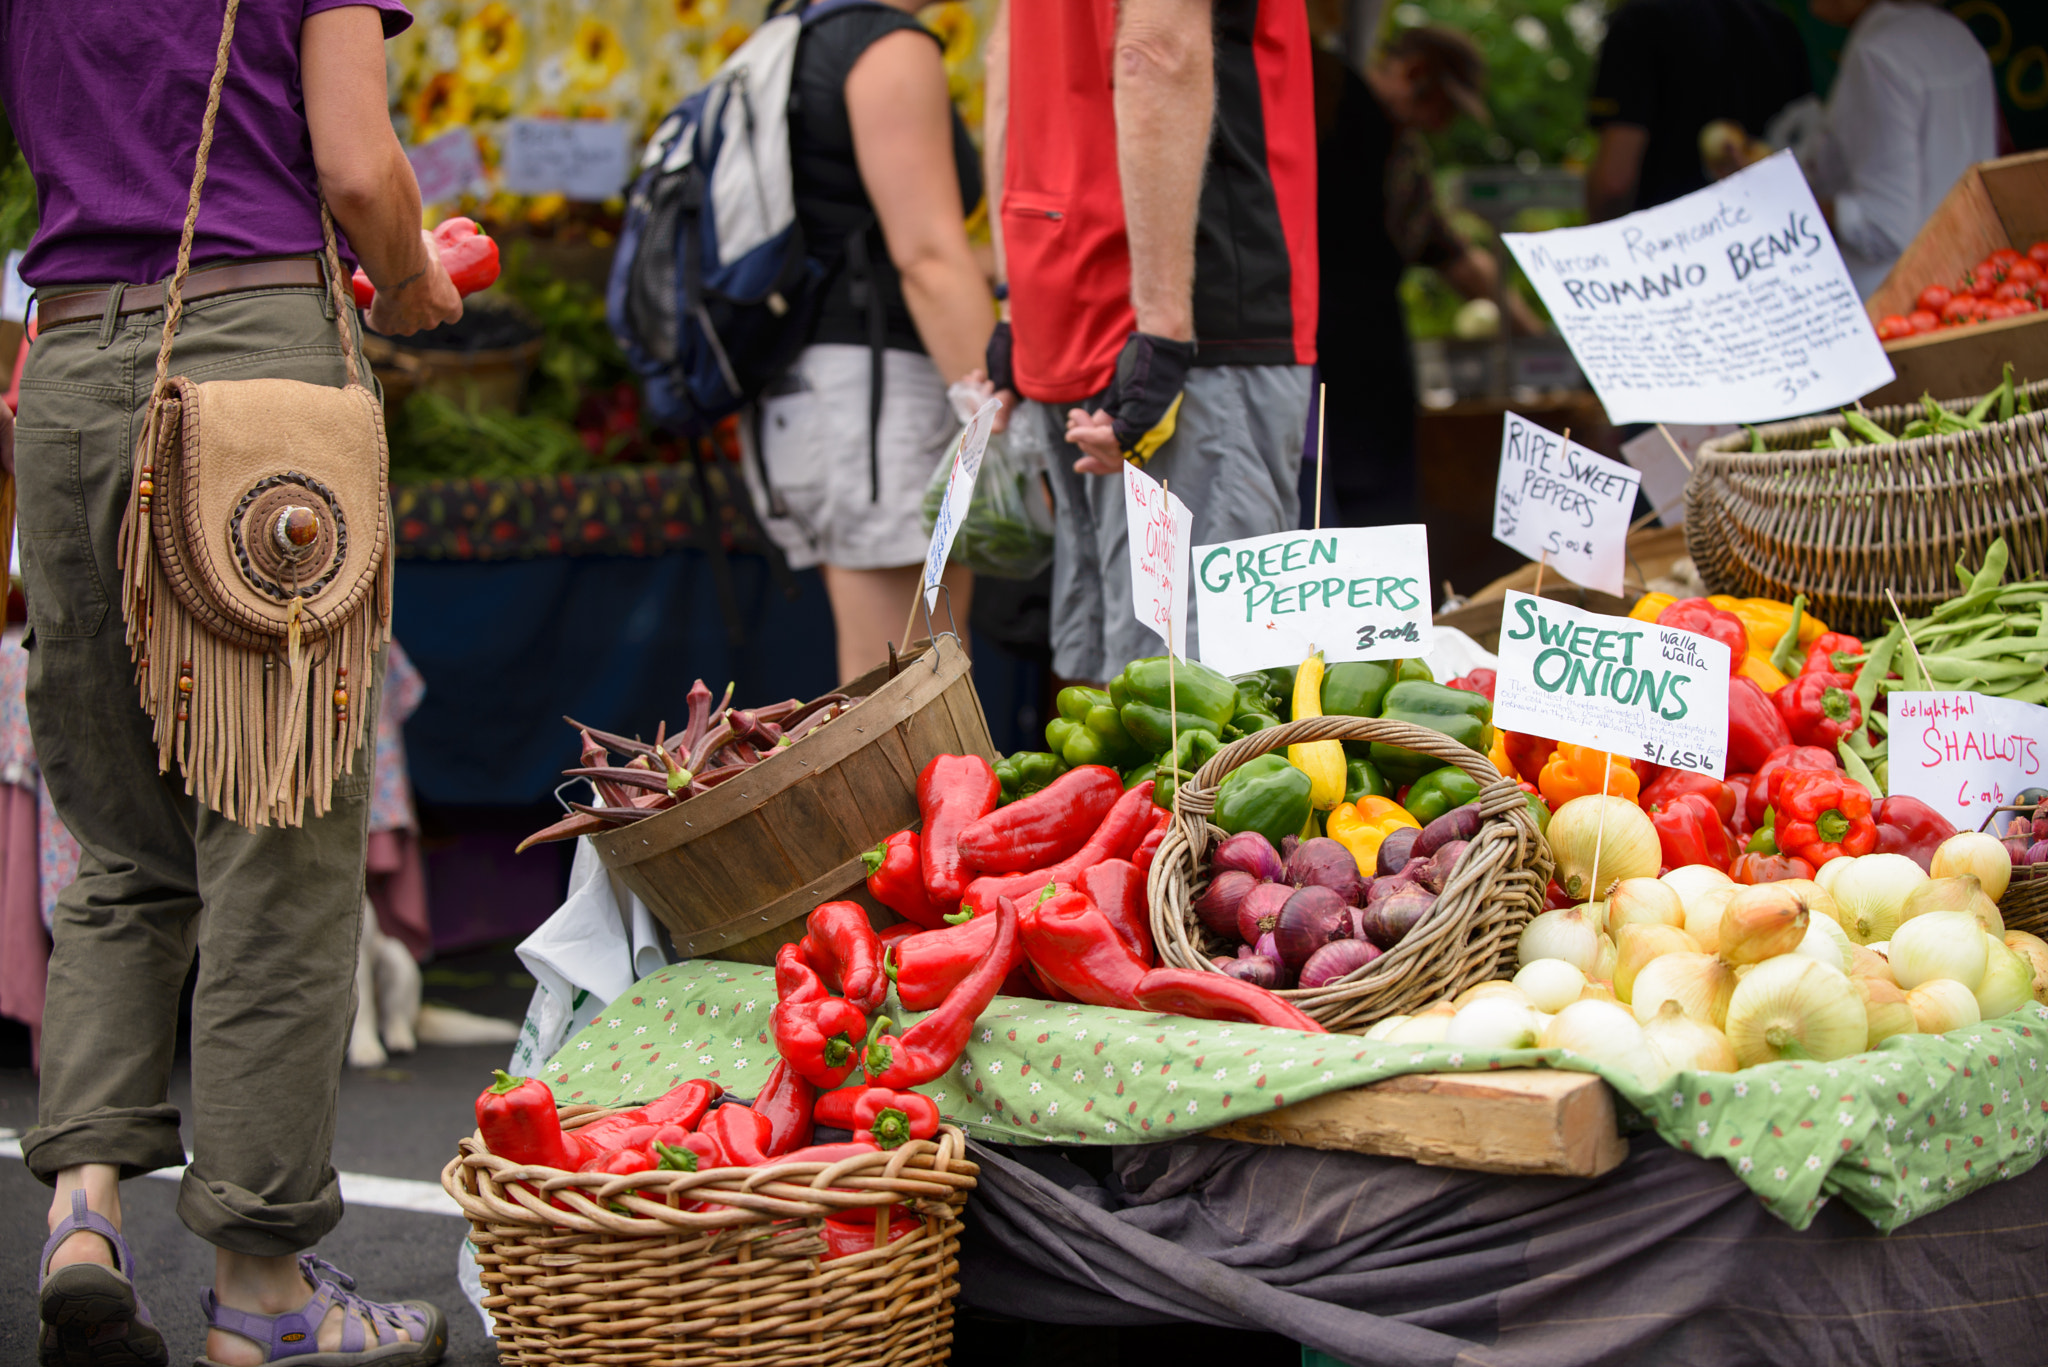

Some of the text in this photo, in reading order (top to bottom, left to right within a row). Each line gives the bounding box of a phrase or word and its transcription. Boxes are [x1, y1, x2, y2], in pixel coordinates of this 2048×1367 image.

[1562, 211, 1821, 311] ROMANO BEANS
[1508, 421, 1640, 503] RIPE SWEET
[1129, 471, 1147, 507] Red
[1522, 469, 1598, 528] PEPPERS
[1200, 537, 1338, 593] GREEN
[1243, 576, 1420, 623] PEPPERS
[1507, 598, 1644, 666] SWEET
[1660, 630, 1698, 655] Walla
[1662, 645, 1709, 671] Walla
[1533, 647, 1691, 721] ONIONS
[1901, 695, 1974, 727] delightful
[1922, 727, 2040, 775] SHALLOTS
